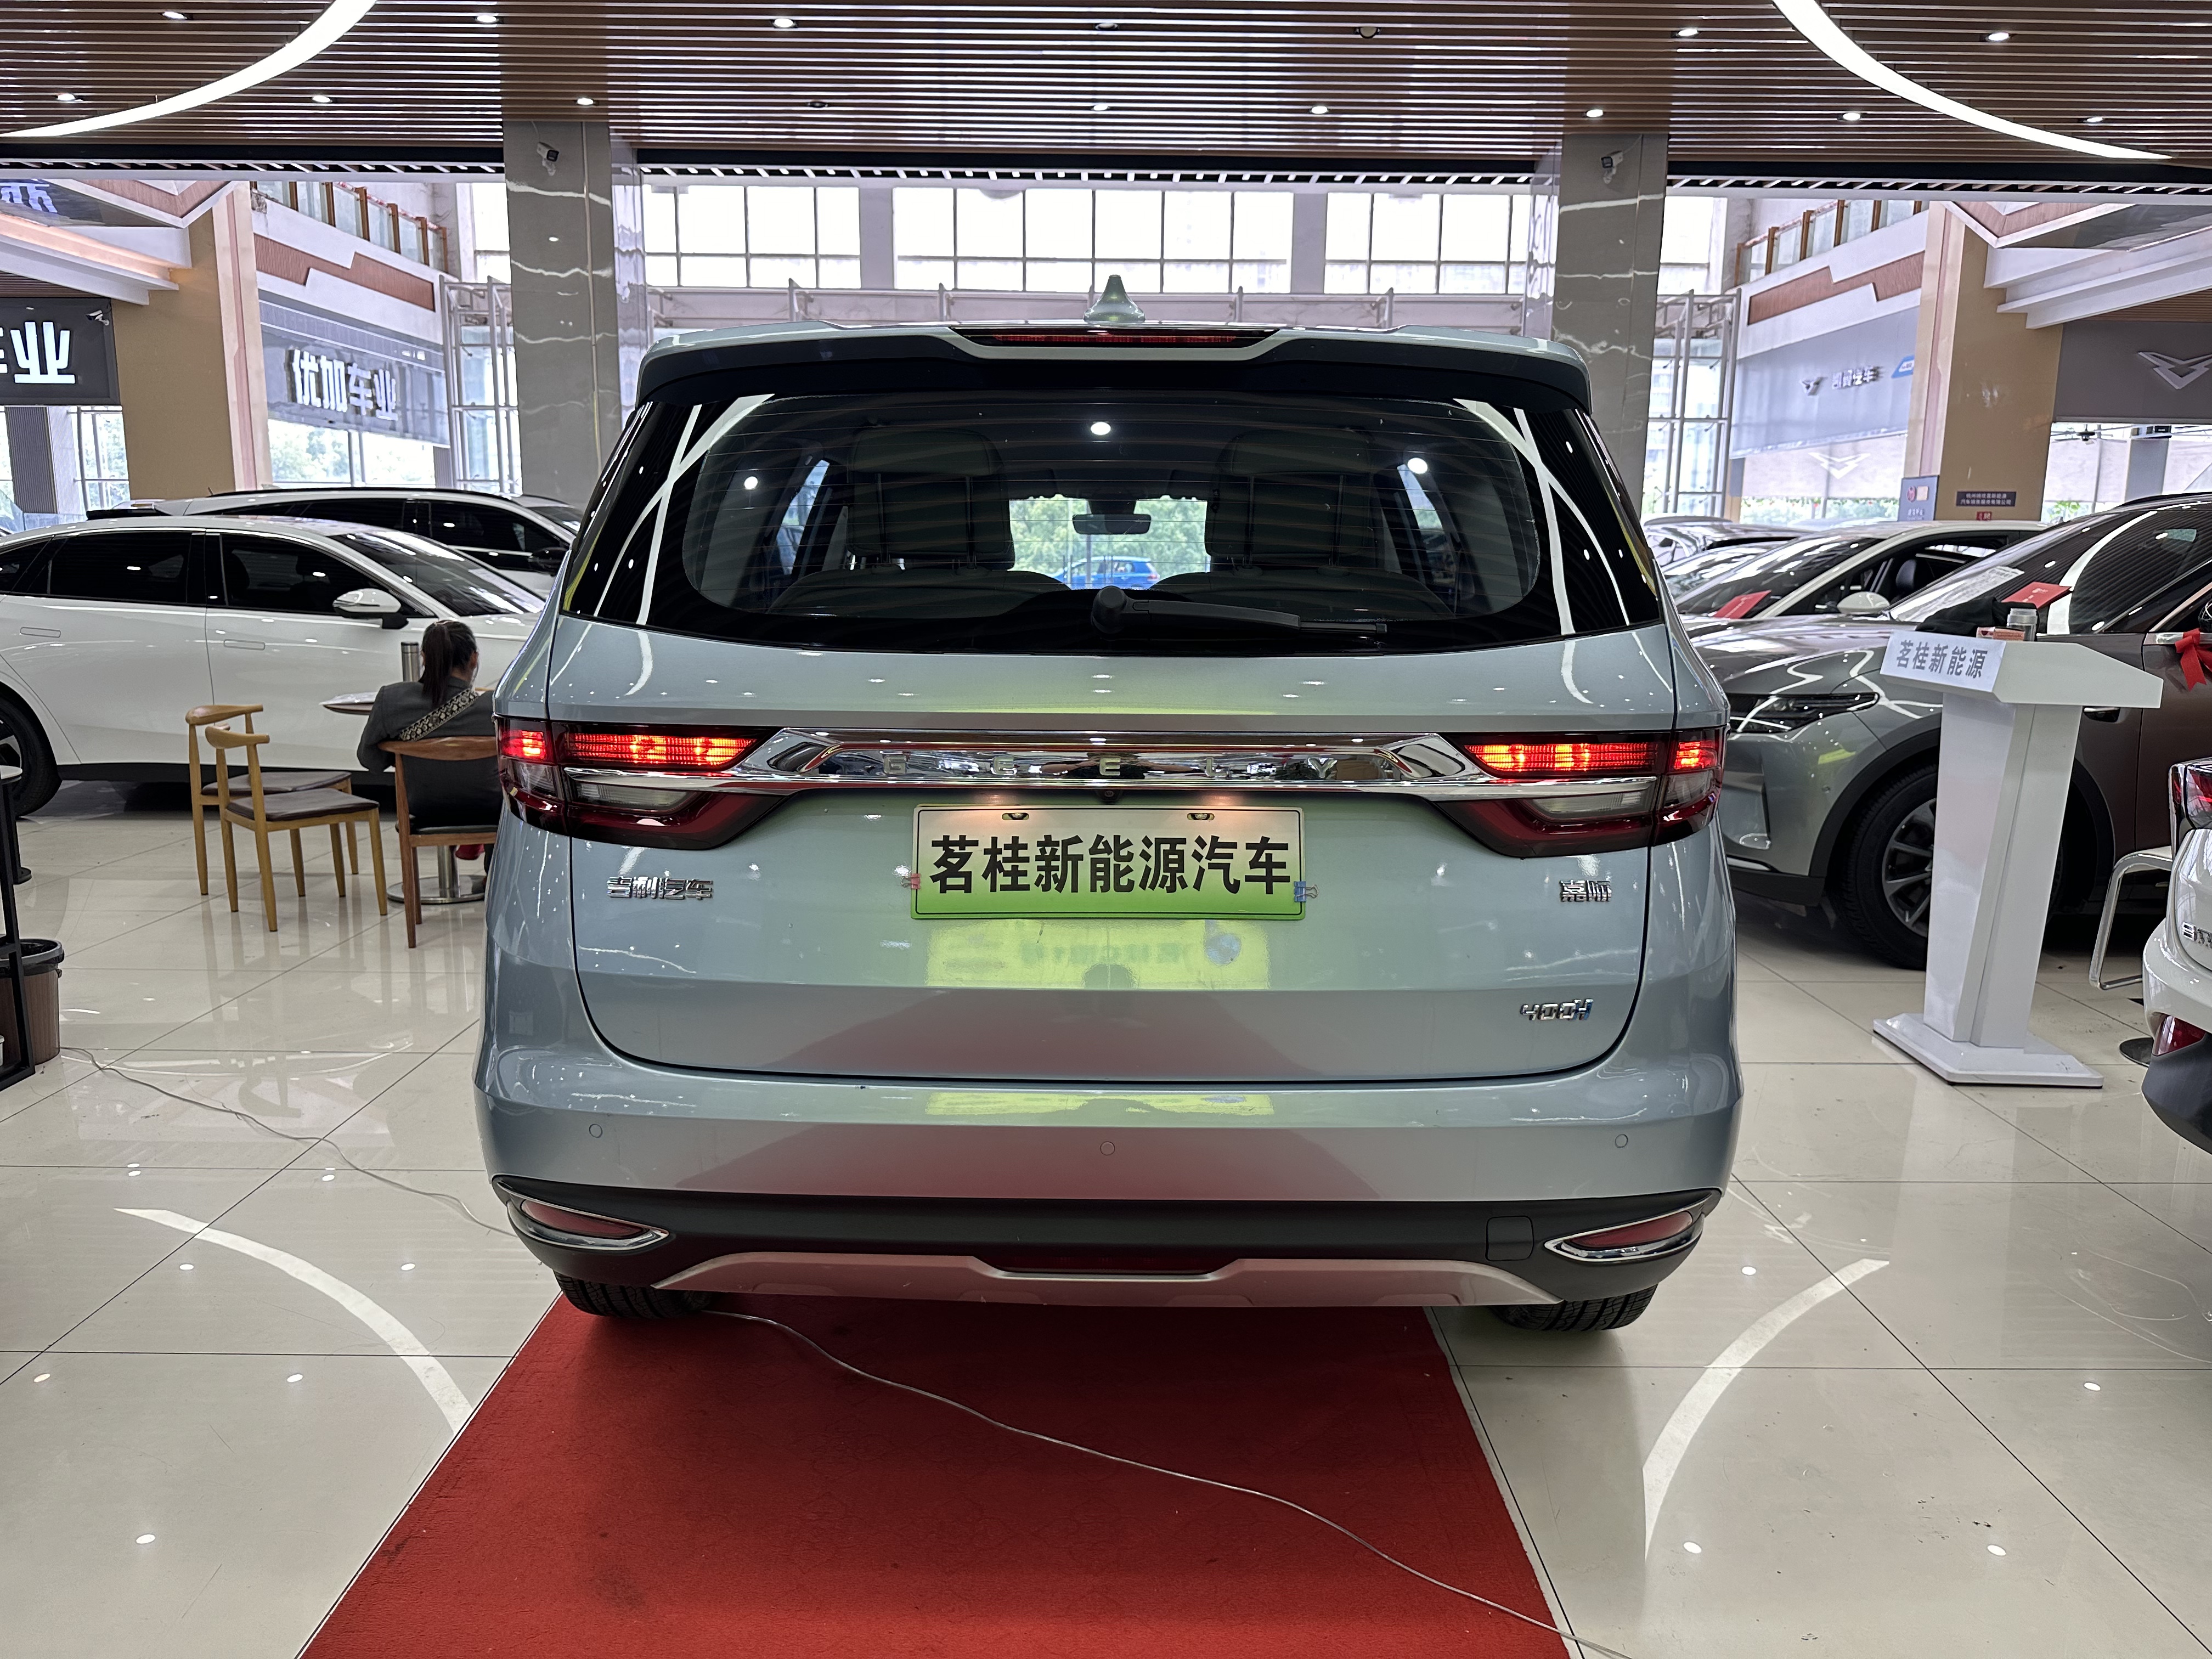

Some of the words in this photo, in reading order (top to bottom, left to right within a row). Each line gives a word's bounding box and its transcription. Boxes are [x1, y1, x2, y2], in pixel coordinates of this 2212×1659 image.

[0, 321, 76, 383] 业
[292, 349, 398, 421] 优加车业
[1896, 639, 1988, 679] 茗桂新能源
[883, 754, 1338, 779] GEELY
[606, 876, 713, 900] 吉利汽车
[929, 834, 1290, 895] 茗桂新能源汽车
